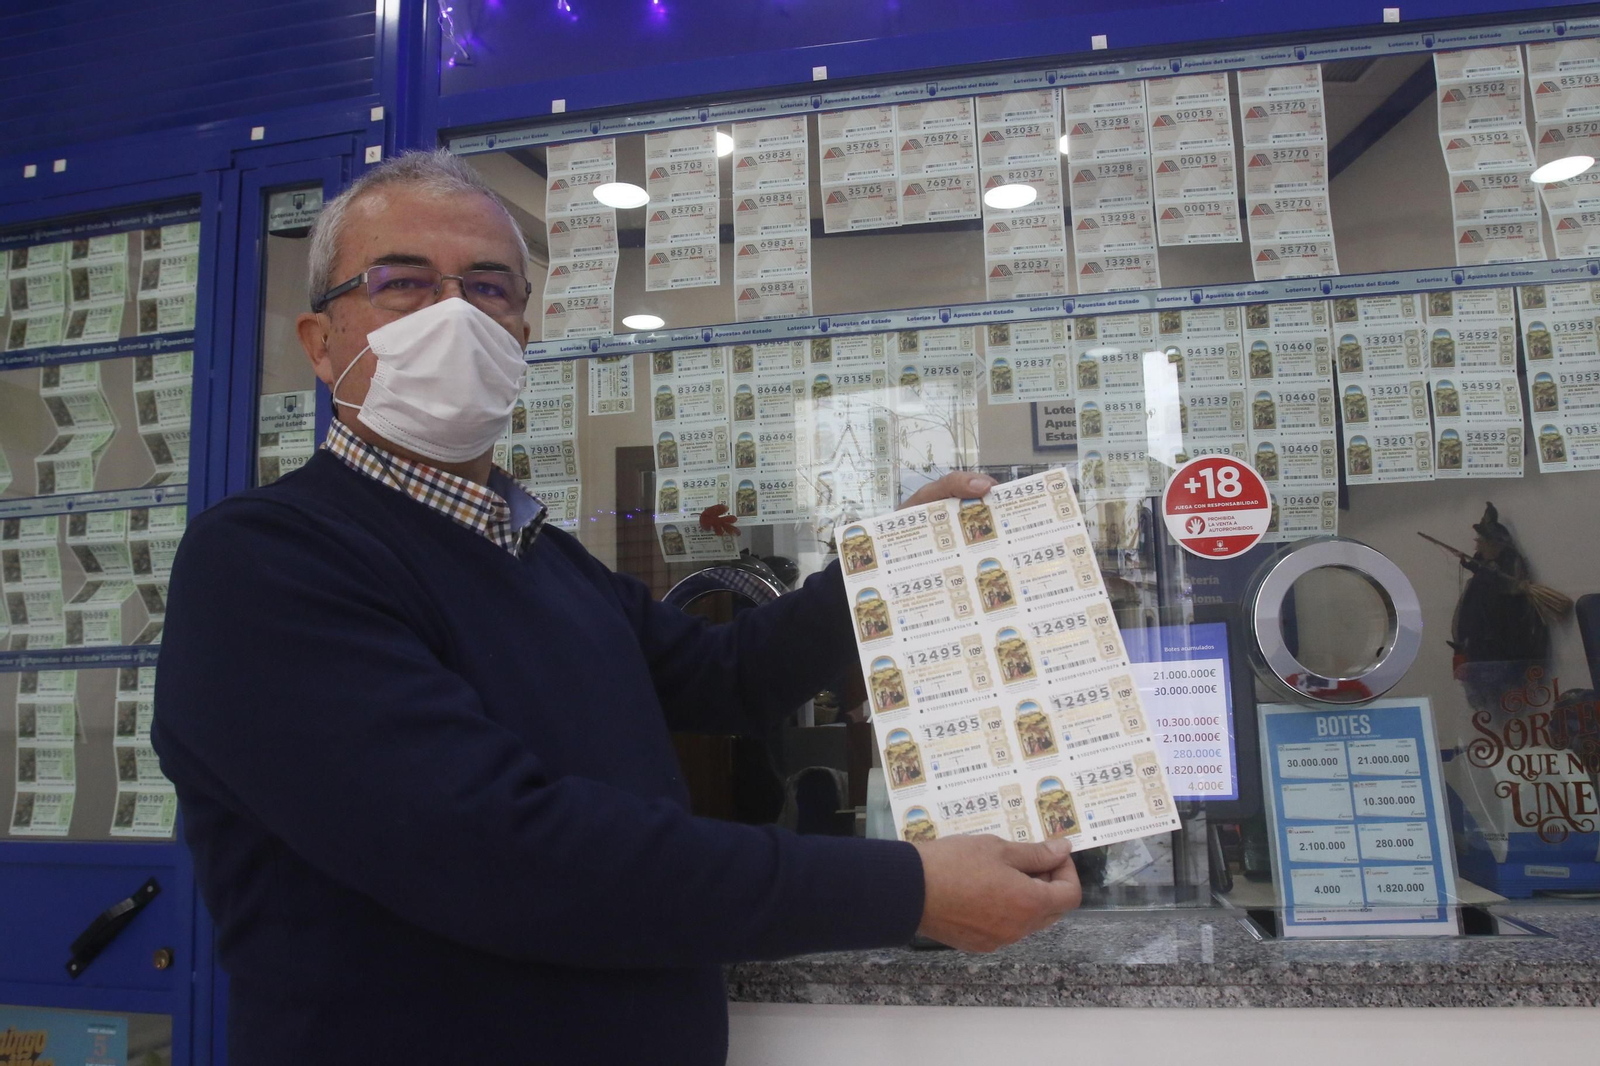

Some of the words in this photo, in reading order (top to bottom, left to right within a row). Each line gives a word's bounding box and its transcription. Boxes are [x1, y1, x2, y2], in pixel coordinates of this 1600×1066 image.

[1561, 76, 1599, 85] 85703
[1468, 83, 1505, 92] 15502
[1269, 102, 1305, 111] 35770
[1176, 110, 1212, 119] 00019
[1094, 118, 1129, 127] 13298
[1006, 126, 1040, 134] 82037
[924, 133, 958, 143] 76976
[846, 141, 880, 150] 35765
[759, 151, 791, 160] 69834
[670, 162, 702, 171] 85703
[1098, 164, 1132, 174] 13298
[571, 173, 601, 182] 92572
[926, 178, 960, 187] 76976
[848, 185, 882, 195] 35765
[1184, 203, 1220, 212] 00019
[1275, 199, 1311, 208] 35770
[1012, 216, 1046, 226] 82037
[1485, 225, 1522, 234] 15502
[670, 248, 702, 257] 85703
[760, 282, 794, 292] 69834
[567, 298, 598, 307] 92572
[1553, 321, 1593, 331] 01953
[1366, 335, 1403, 345] 13201
[1459, 331, 1497, 340] 54592
[1275, 342, 1312, 351] 10460
[1187, 347, 1224, 357] 94139
[1102, 353, 1138, 362] 88518
[1016, 359, 1051, 368] 92837
[924, 366, 959, 375] 78756
[836, 374, 871, 384] 78155
[678, 384, 711, 394] 83263
[758, 385, 792, 394] 86464
[1190, 397, 1227, 406] 94139
[1278, 393, 1315, 402] 10460
[530, 400, 560, 408] 79901
[1105, 402, 1142, 411] 88518
[1467, 432, 1506, 441] 54592
[1376, 437, 1414, 446] 13201
[530, 446, 561, 455] 79901
[683, 479, 716, 488] 83263
[760, 481, 794, 490] 86464
[1184, 466, 1243, 499] +18
[995, 481, 1044, 501] 12495
[1207, 500, 1259, 508] RESPONSABILIDAD
[1283, 496, 1320, 504] 10460
[877, 513, 927, 532] 12495
[1013, 546, 1065, 566] 12495
[892, 576, 943, 596] 12495
[1033, 615, 1087, 636] 12495
[907, 645, 961, 665] 12495
[1153, 669, 1216, 681] 21.000.000€
[1154, 685, 1218, 696] 30.000.000€
[1054, 687, 1110, 709] 12495
[1128, 718, 1138, 726] 20
[1156, 716, 1220, 727] 10.300.000€
[1316, 714, 1371, 736] BOTES
[924, 718, 979, 739] 12495
[1163, 733, 1221, 743] 2.100.000€
[1173, 749, 1222, 759] 280.000€
[1287, 758, 1338, 768] 30.000.000
[1357, 755, 1410, 765] 21.000.000
[1165, 765, 1223, 775] 1.820.000€
[1507, 753, 1560, 781] QUE
[1076, 764, 1133, 786] 12495
[1188, 782, 1224, 791] 4.000€
[1363, 796, 1415, 806] 10.300.000
[942, 795, 999, 817] 12495
[1494, 781, 1598, 833] UNE
[1299, 841, 1345, 851] 2.100.000
[1375, 839, 1414, 848] 280.000
[1314, 885, 1341, 894] 4.000
[1377, 883, 1425, 893] 1.820.000
